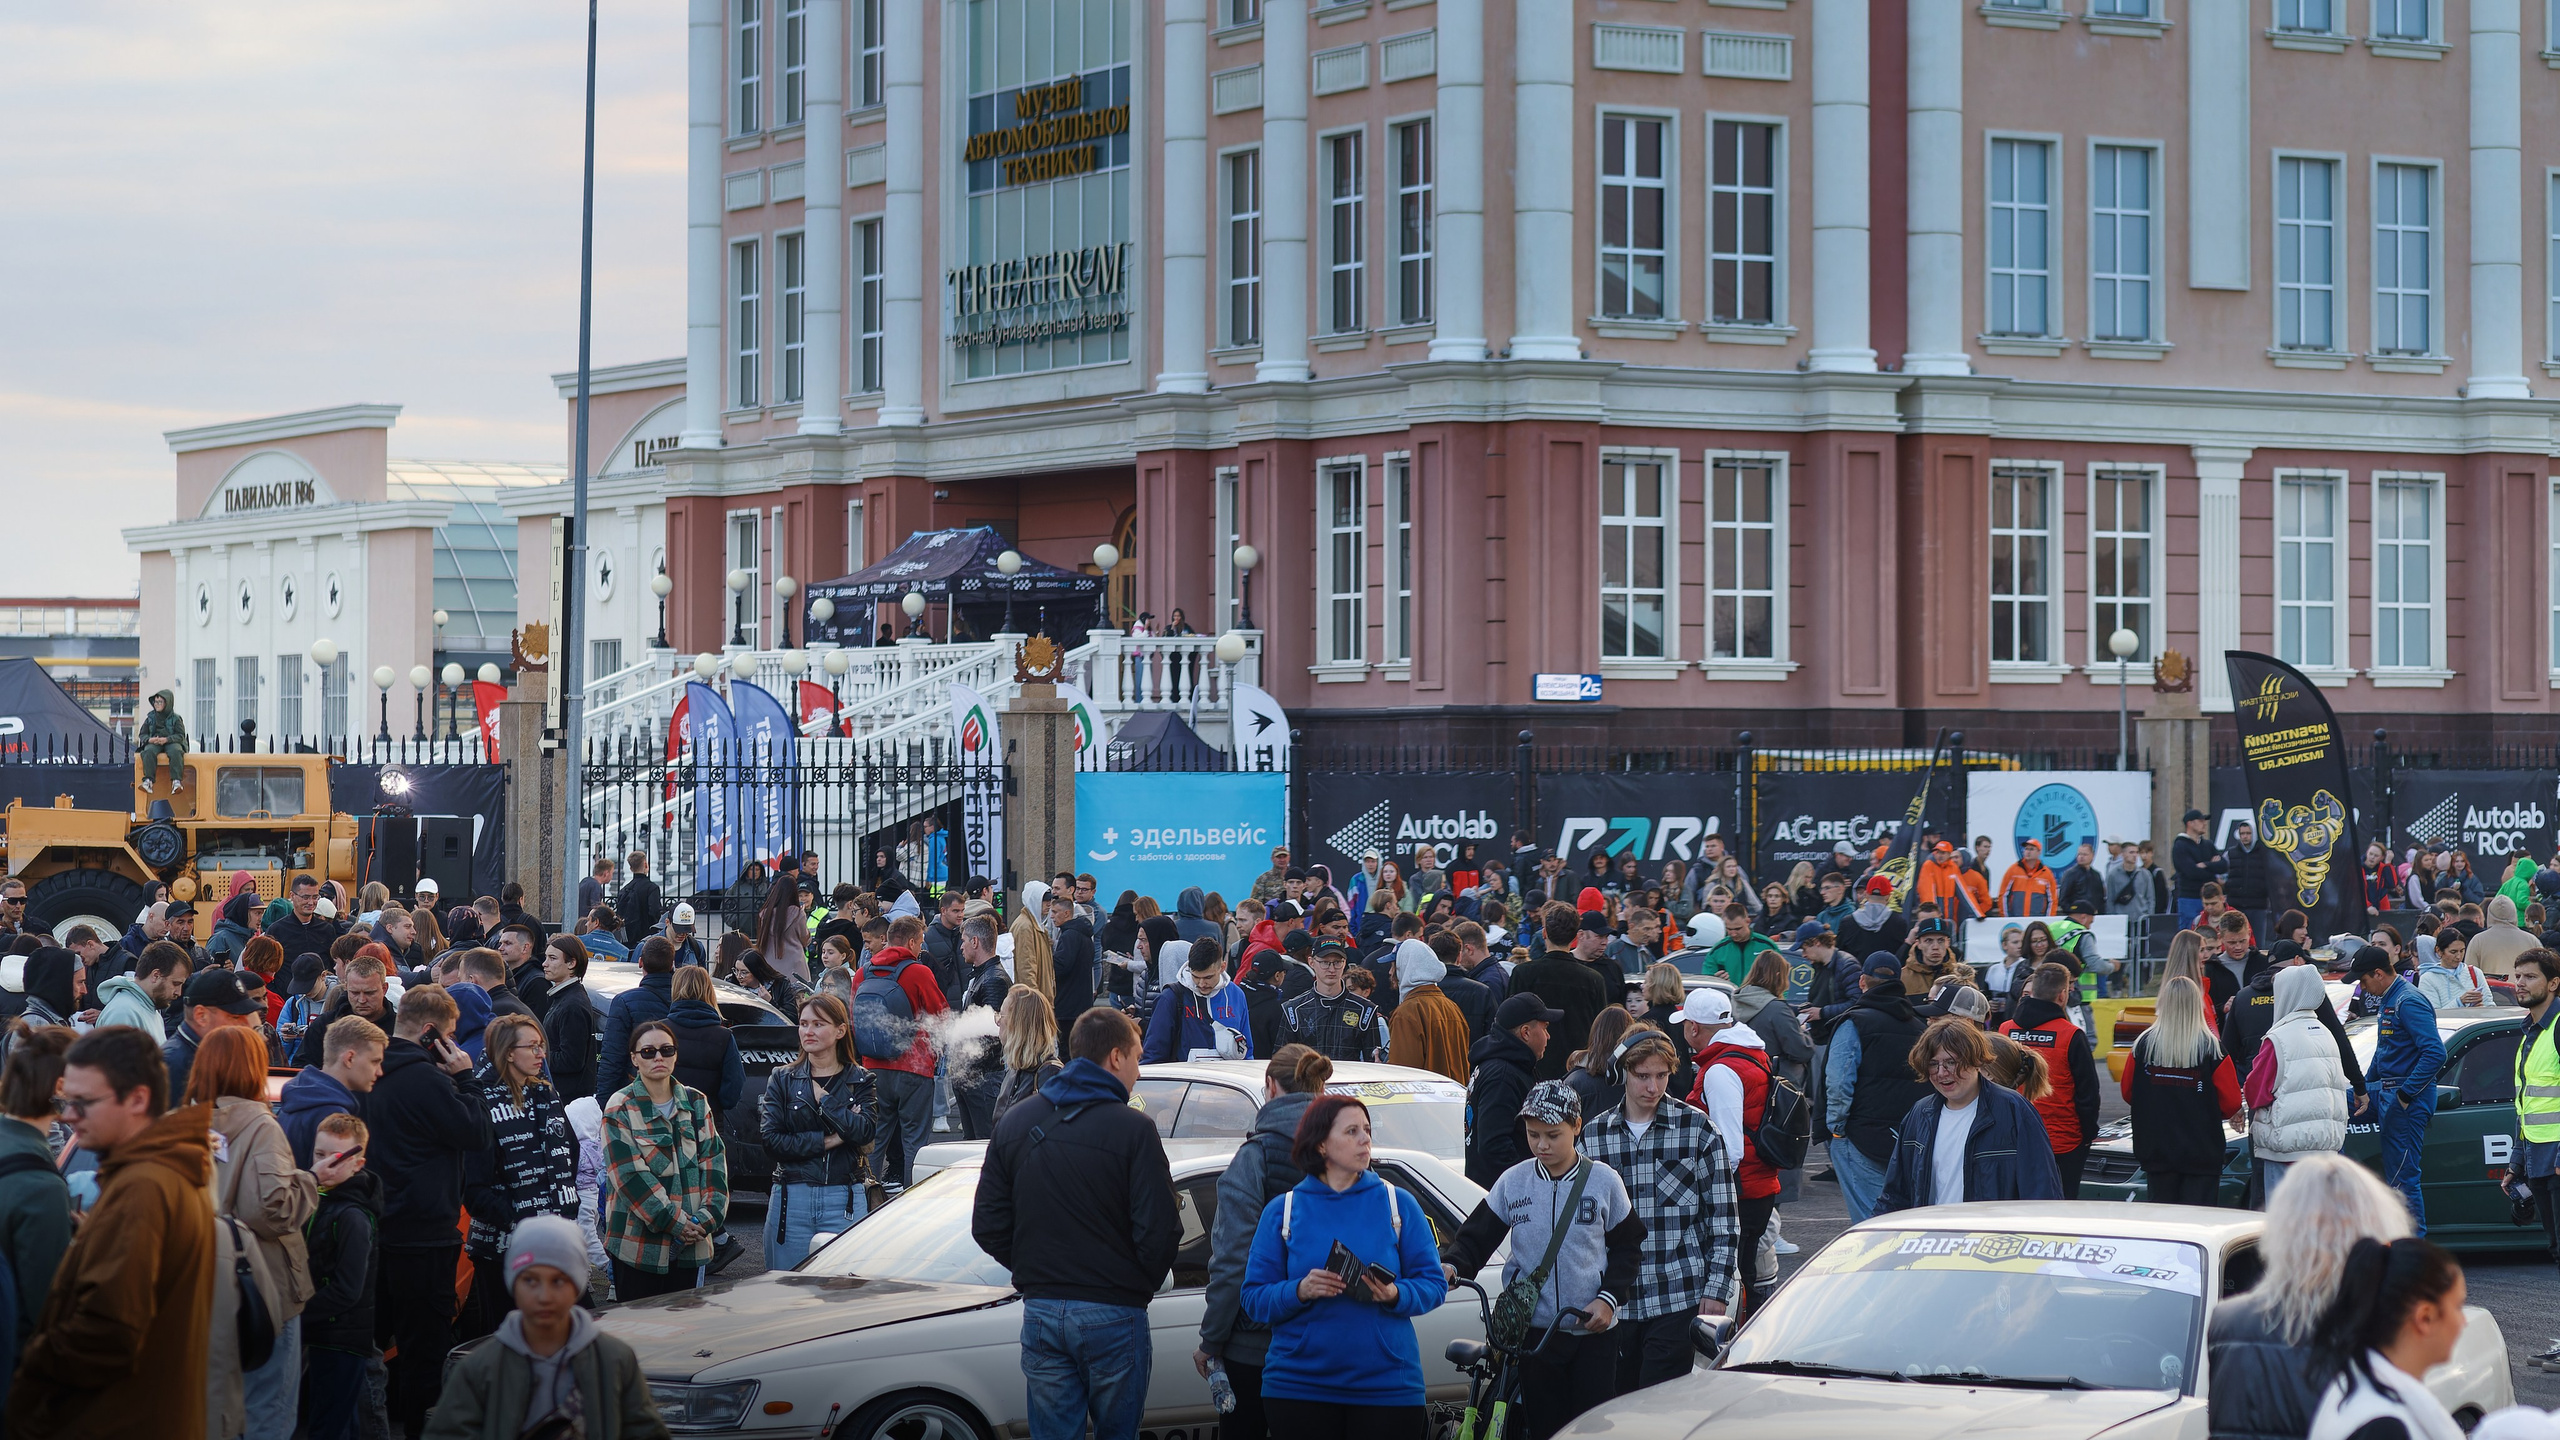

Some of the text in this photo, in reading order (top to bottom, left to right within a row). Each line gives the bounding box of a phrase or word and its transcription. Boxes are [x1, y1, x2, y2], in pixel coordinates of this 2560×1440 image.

[1015, 74, 1082, 121] МУЗЕЙ
[963, 97, 1130, 162] АВТОМОБИЛЬНОЙ
[1003, 145, 1096, 186] ТЕХНИКИ
[949, 243, 1124, 317] THEATRUM
[951, 311, 1120, 349] частный универсальный театр
[225, 479, 315, 513] ПАВИЛЬОН №6
[1396, 810, 1498, 840] Autolab
[2463, 801, 2546, 829] Autolab
[1130, 822, 1267, 849] эдельвейс
[1396, 843, 1412, 855] BY
[2463, 831, 2526, 855] BY RCC
[1137, 852, 1174, 861] заботой
[1184, 853, 1226, 862] здоровье
[1386, 1082, 1436, 1095] GAMES
[1575, 1196, 1598, 1225] B
[1897, 1238, 2117, 1263] DRIFT GAMES
